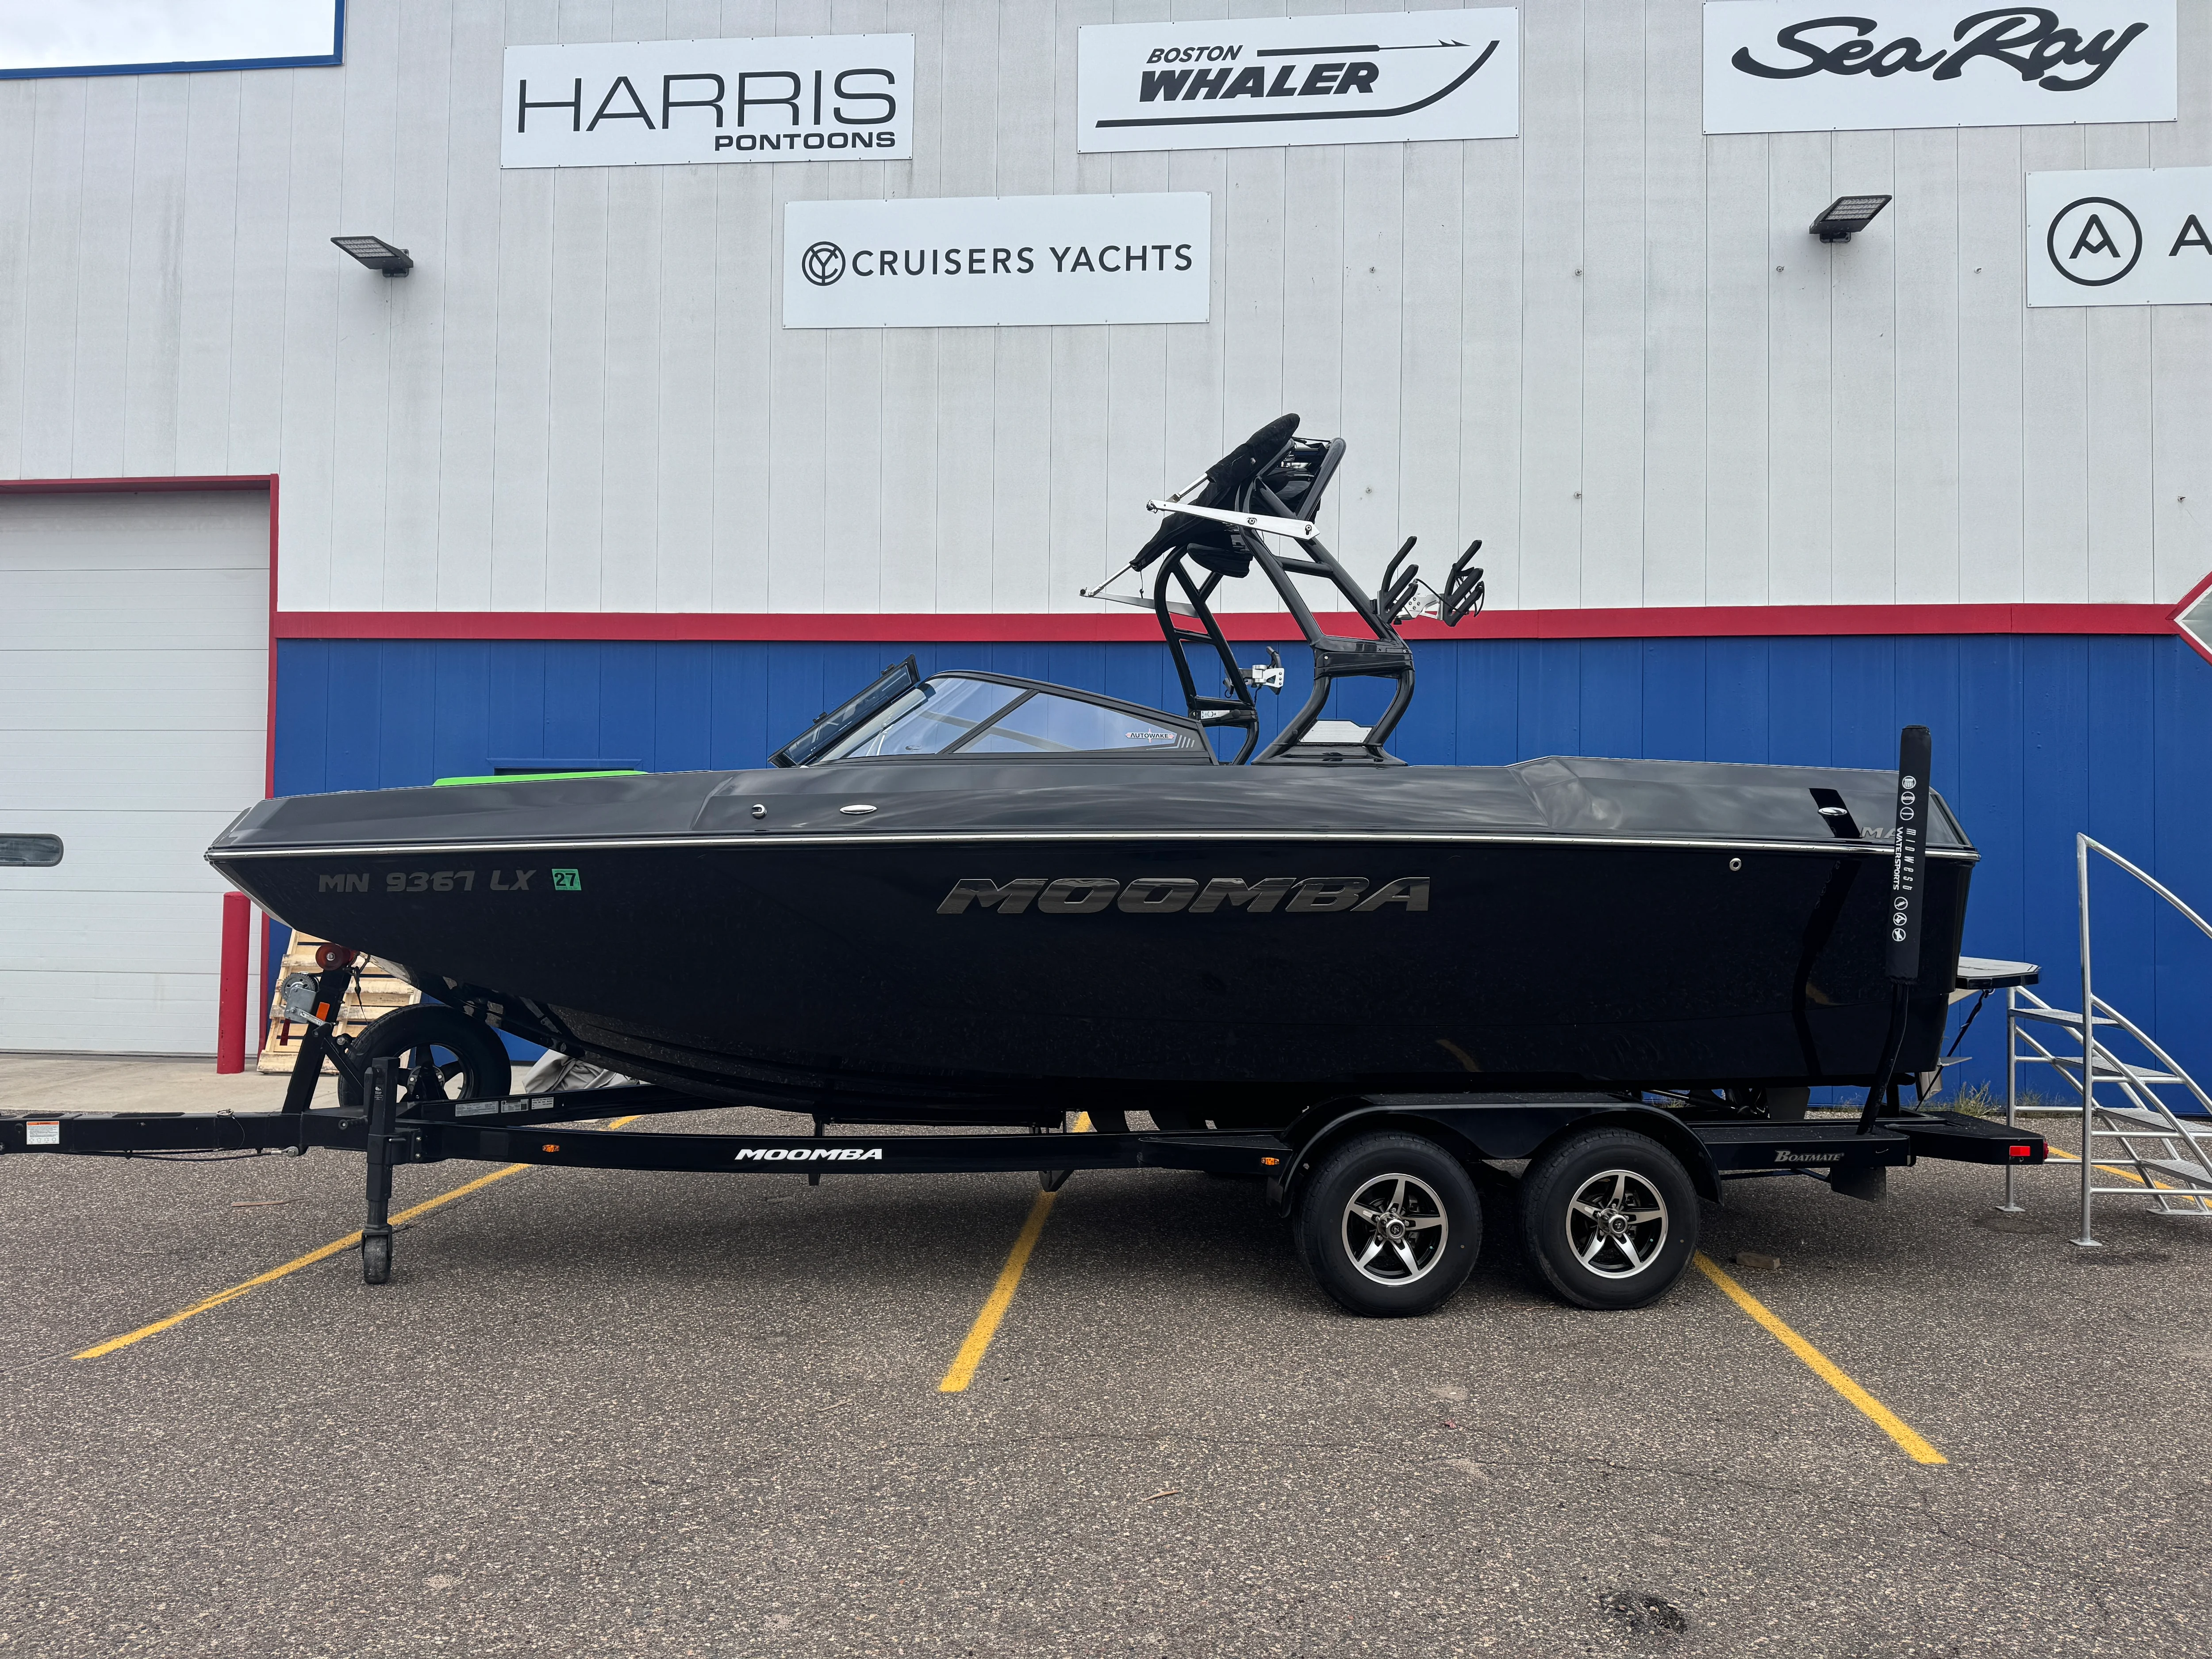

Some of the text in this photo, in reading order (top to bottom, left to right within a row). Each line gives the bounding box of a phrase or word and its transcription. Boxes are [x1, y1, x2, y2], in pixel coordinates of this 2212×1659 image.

[1146, 45, 1243, 64] BOSTON
[1731, 7, 2149, 92] Sea Ray
[1139, 61, 1379, 102] WHALER
[518, 68, 896, 133] HARRIS
[714, 131, 895, 151] PONTOONS
[852, 247, 1034, 276] CRUISERS
[1049, 244, 1192, 273] YACHTS
[1893, 826, 1904, 891] WATERSPORTS
[319, 870, 537, 892] MN 9367 LX
[554, 872, 576, 887] 27
[936, 877, 1430, 914] MOOMBA
[734, 1148, 882, 1160] MOOMBA
